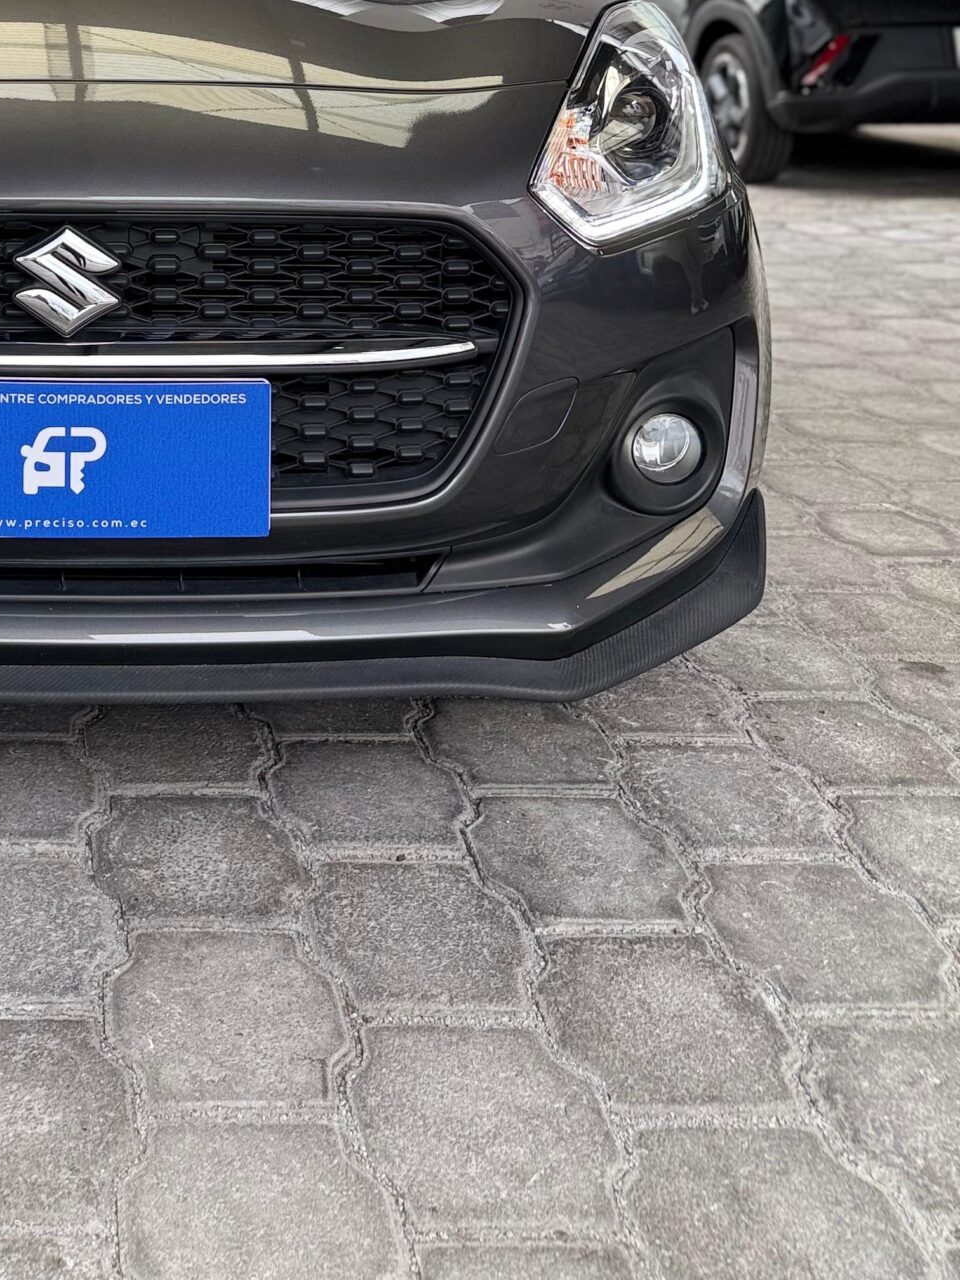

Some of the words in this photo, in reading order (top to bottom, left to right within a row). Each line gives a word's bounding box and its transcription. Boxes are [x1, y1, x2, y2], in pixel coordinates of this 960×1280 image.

[37, 393, 143, 405] COMPRADORES
[144, 394, 155, 404] Y
[156, 393, 247, 405] VENDEDORES
